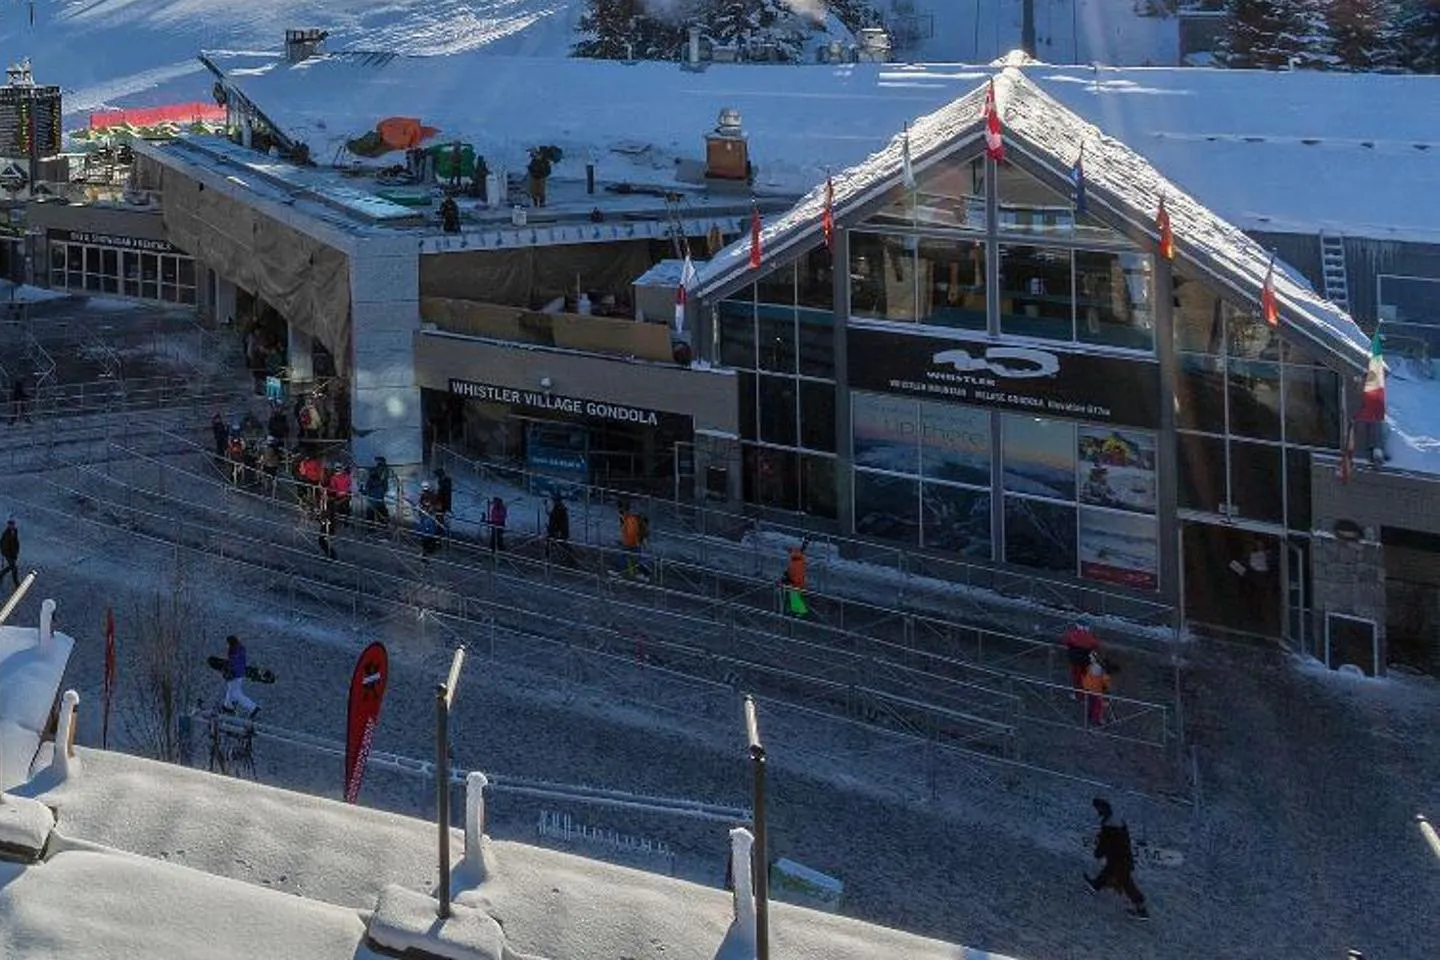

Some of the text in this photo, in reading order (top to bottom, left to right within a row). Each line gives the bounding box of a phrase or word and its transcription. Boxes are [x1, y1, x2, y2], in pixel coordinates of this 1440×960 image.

[452, 381, 658, 426] WHISTLER VILLAGE GONDOLA
